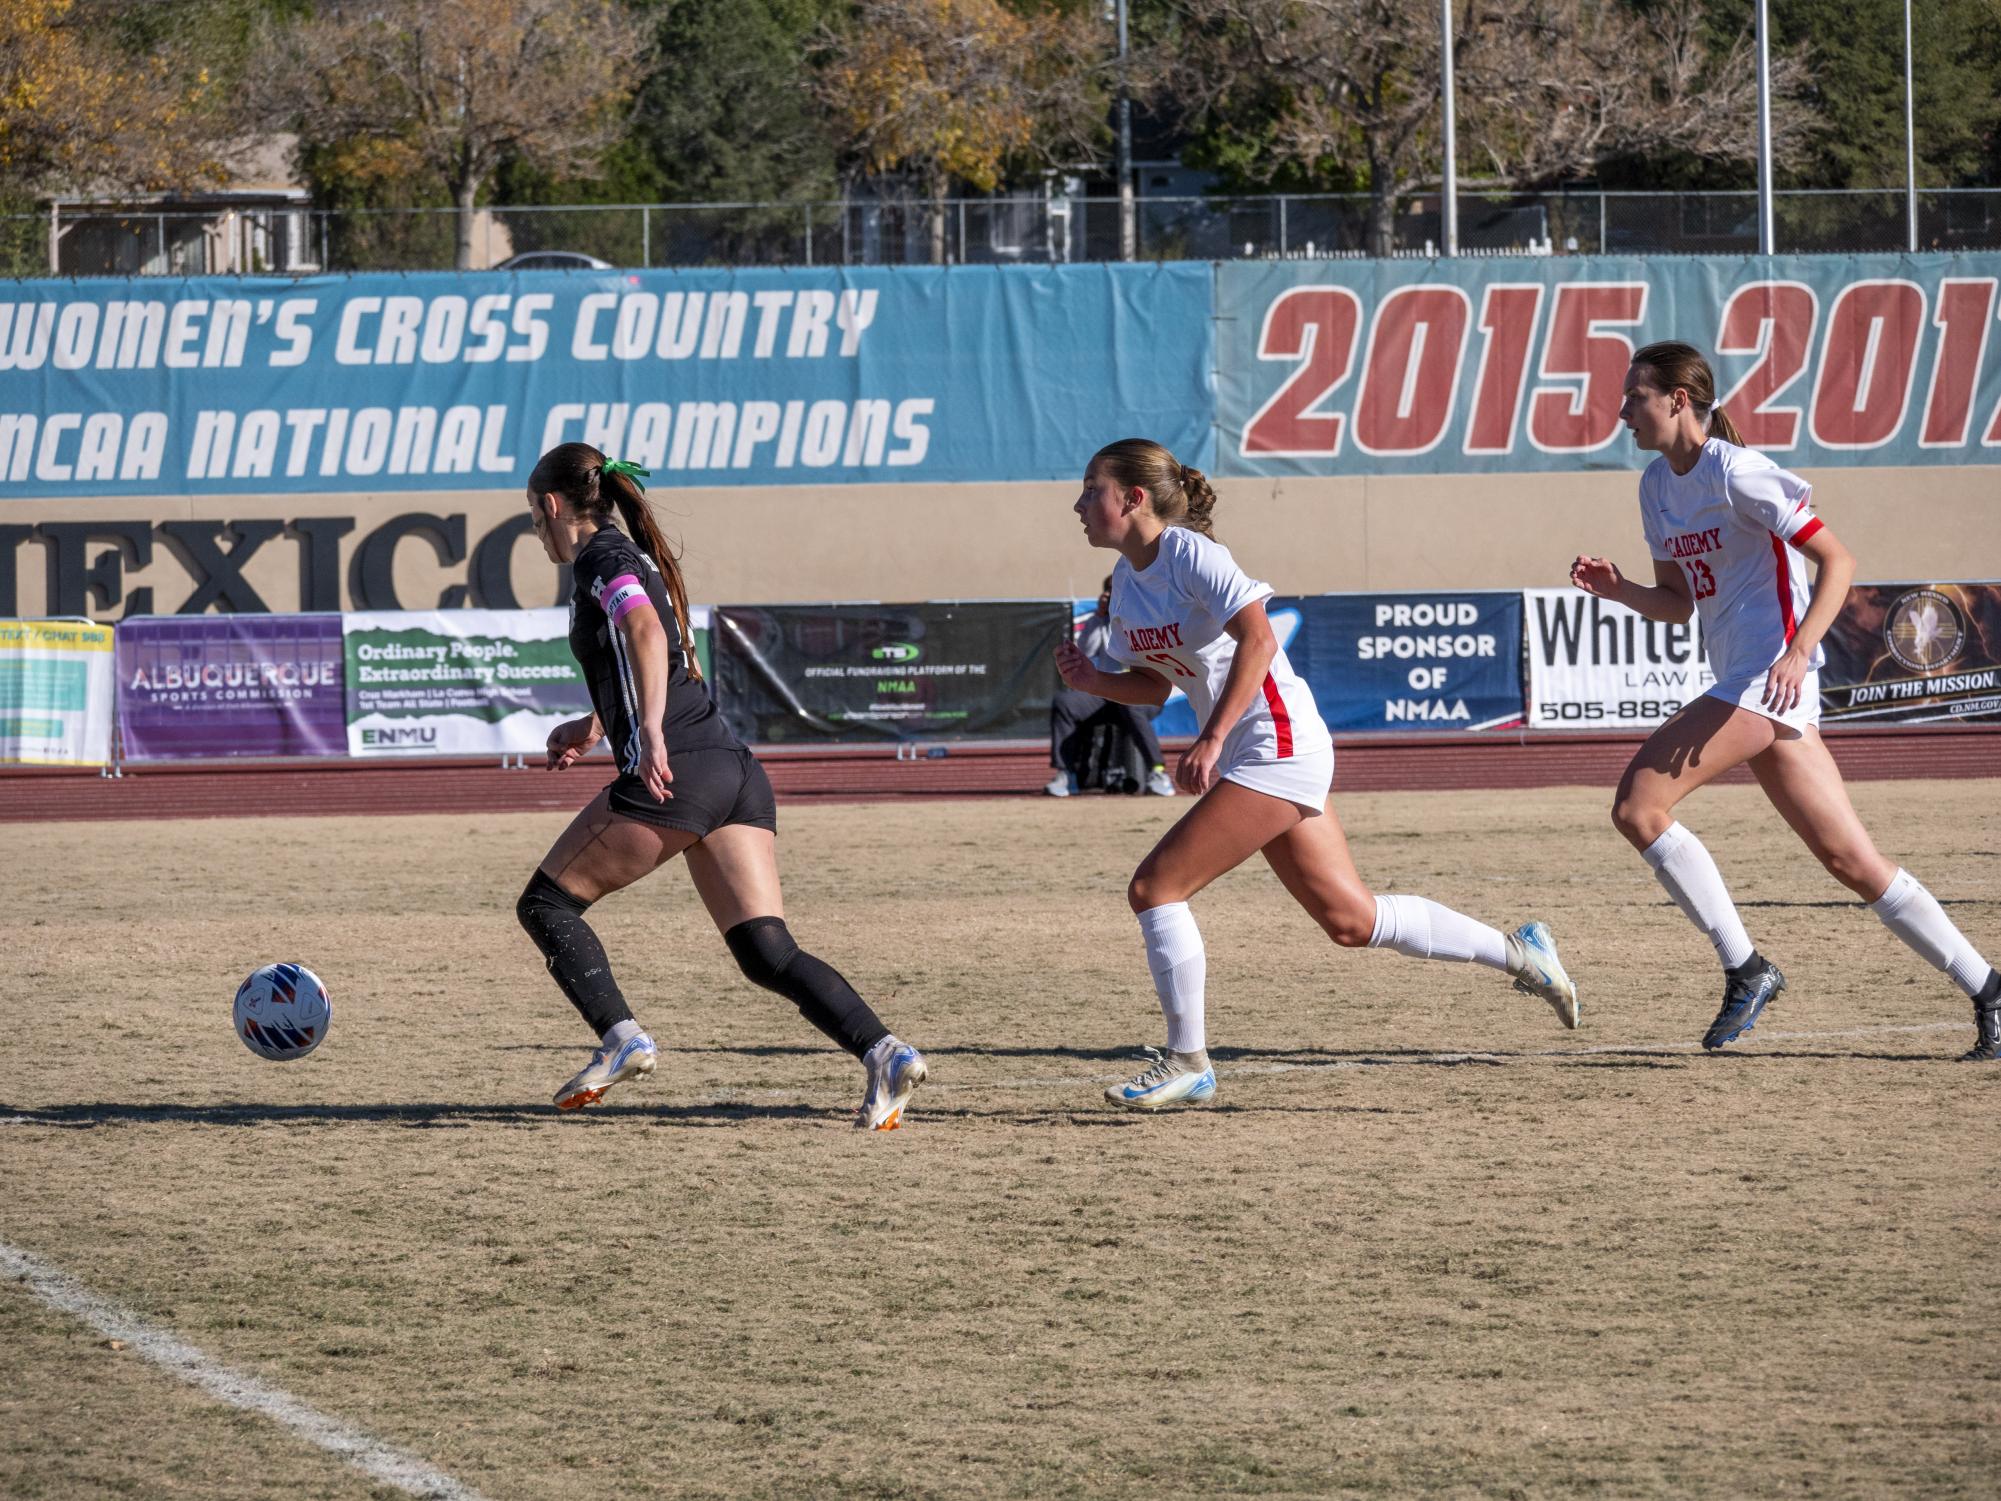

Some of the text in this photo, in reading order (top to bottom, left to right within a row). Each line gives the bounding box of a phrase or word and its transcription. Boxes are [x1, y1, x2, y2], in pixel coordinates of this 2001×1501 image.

[0, 289, 879, 370] WOMEN'S CROSS COUNTRY
[1240, 281, 1649, 457] 2015
[1715, 277, 2001, 450] 201
[0, 398, 934, 483] NCAA NATIONAL CHAMPIONS
[1665, 527, 1722, 558] CADEMY
[1686, 559, 1716, 600] 13
[1376, 603, 1478, 627] PROUD
[358, 641, 519, 662] Ordinary People.
[1357, 634, 1496, 660] SPONSOR
[131, 662, 335, 690] ALBUQUERQUE
[358, 662, 577, 684] Extraordinary Success.
[805, 664, 986, 678] OFFICIAL FUNDRAISING PLATFORM OF THE
[1408, 667, 1447, 690] OF
[1625, 671, 1688, 688] LAW
[151, 689, 313, 703] SPORTS COMMISSION
[877, 680, 916, 693] NMAA
[1848, 671, 1995, 707] JOIN THE MISSION
[1385, 699, 1471, 721] NMAA
[362, 728, 436, 744] ENMU
